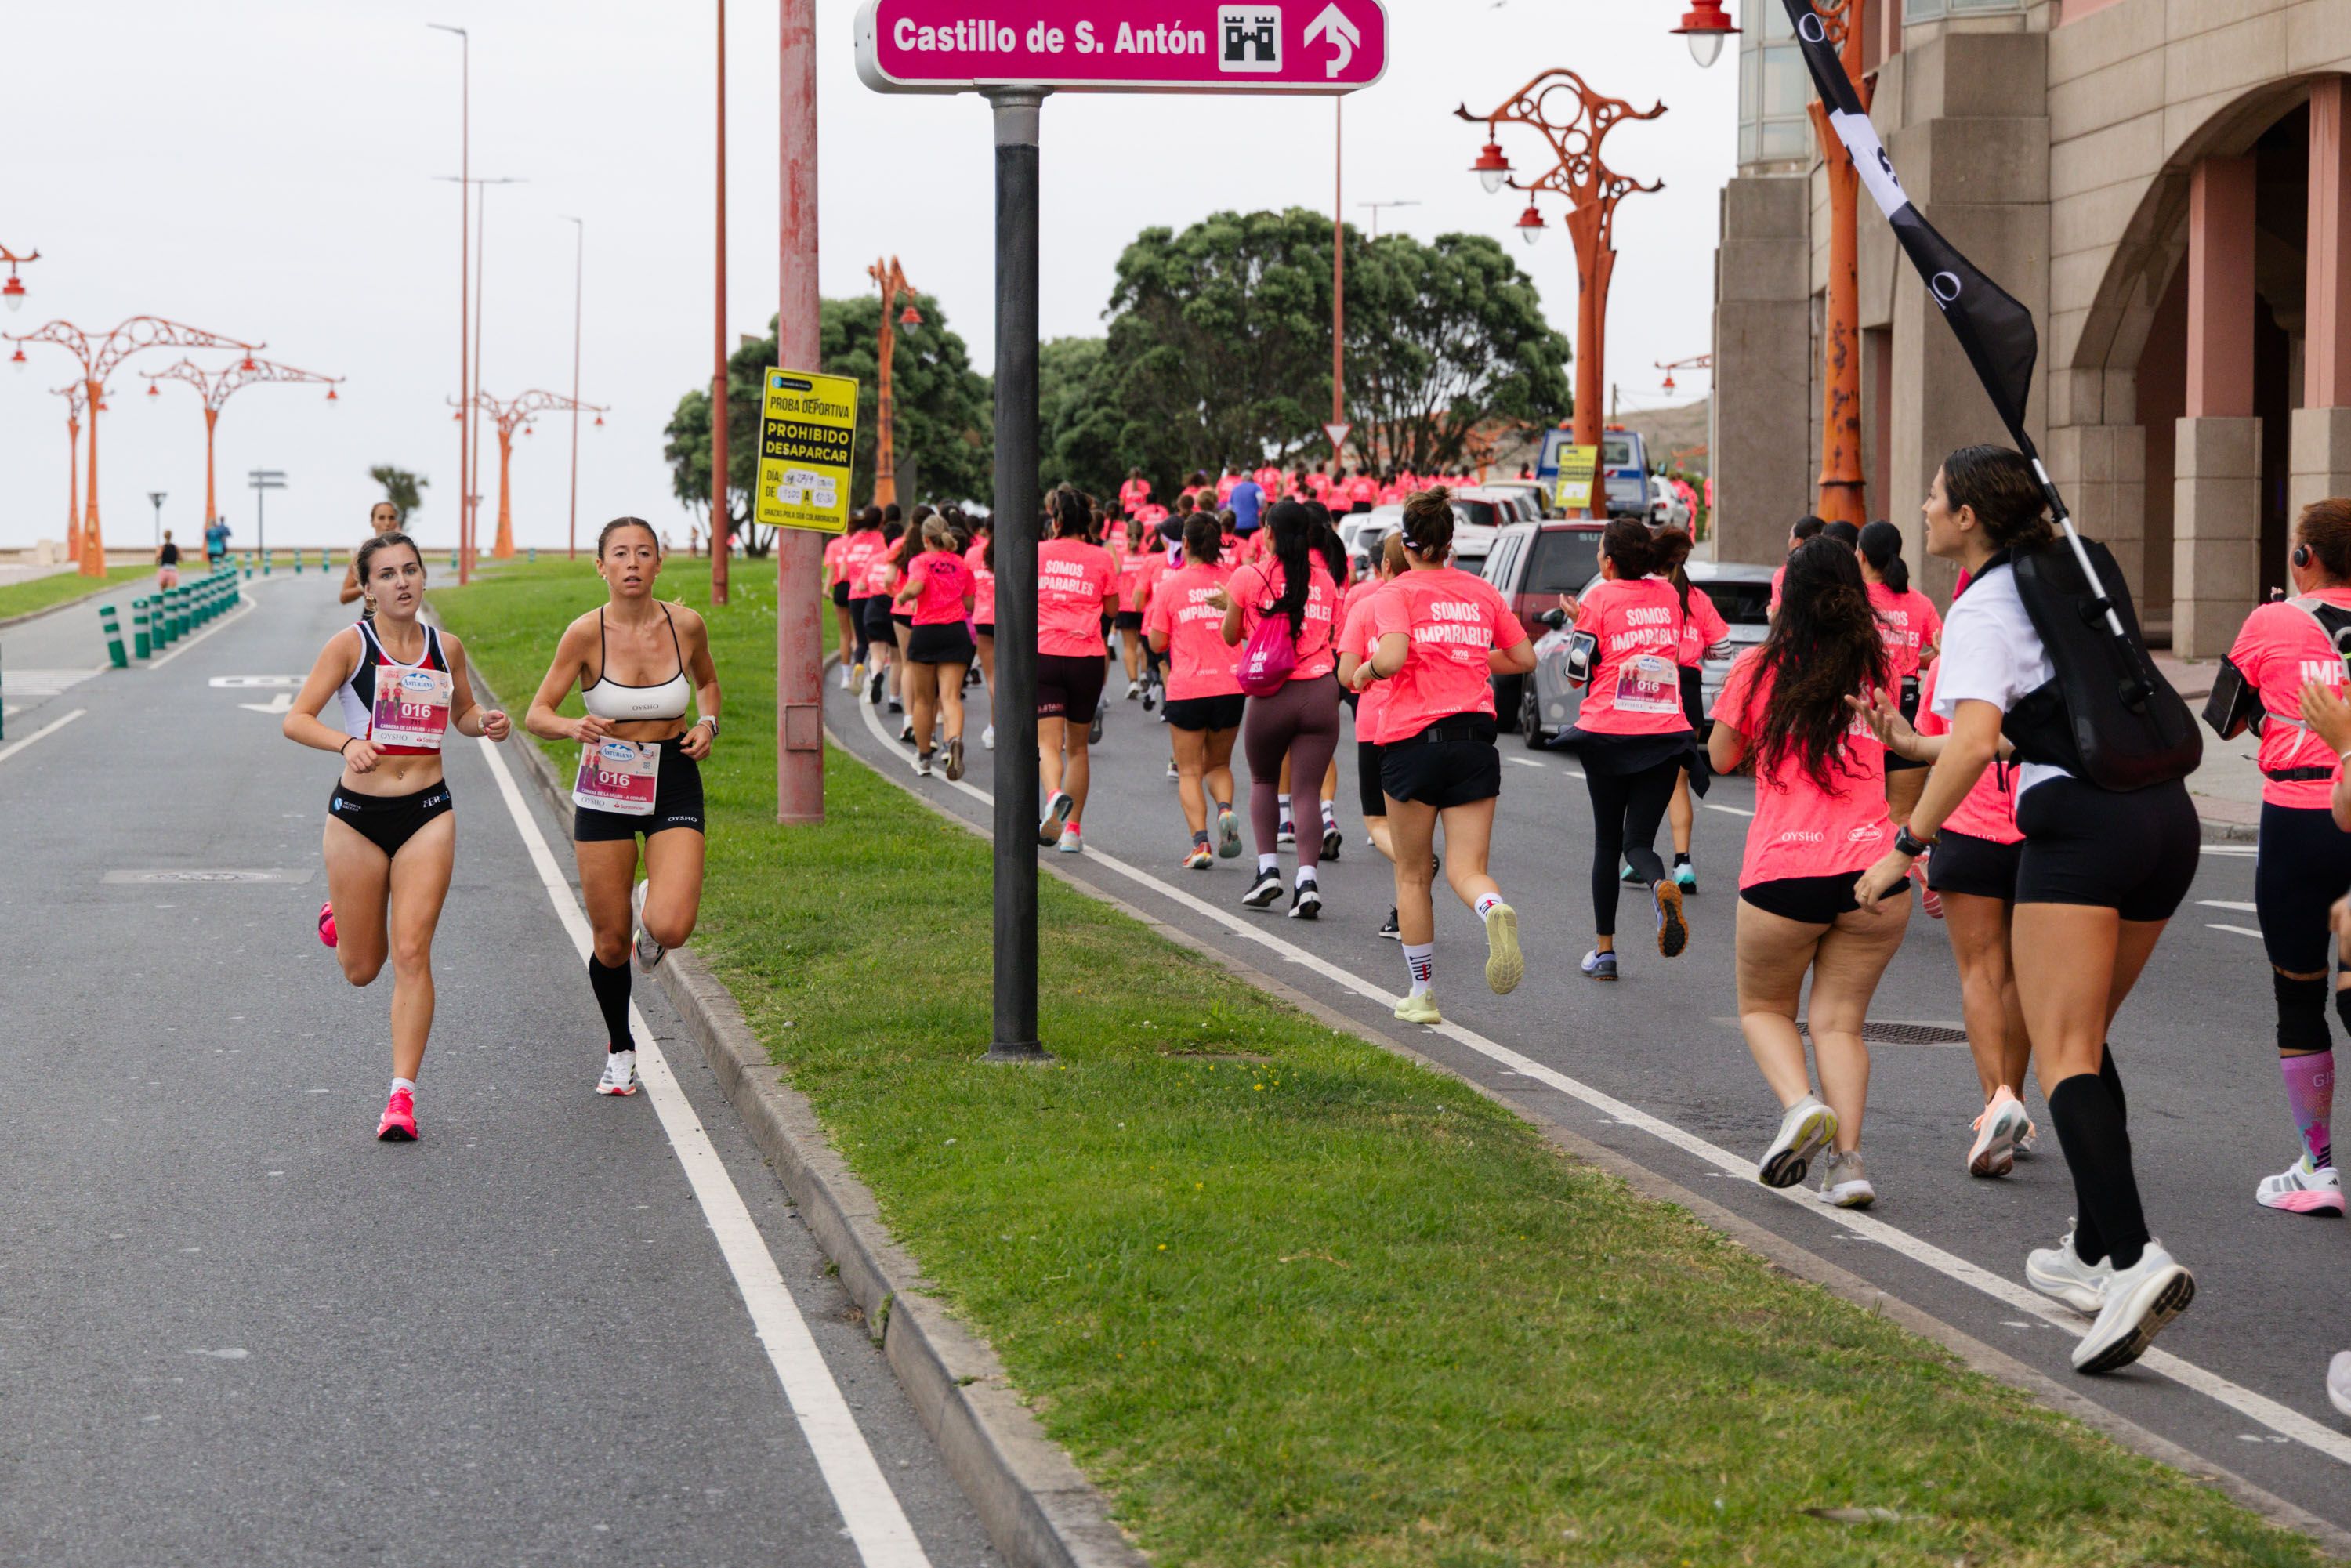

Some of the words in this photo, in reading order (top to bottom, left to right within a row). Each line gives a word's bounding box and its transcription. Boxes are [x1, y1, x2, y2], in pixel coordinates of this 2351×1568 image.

[893, 17, 1017, 53] Castillo
[1026, 20, 1066, 54] de
[1074, 20, 1104, 55] S.
[1114, 20, 1206, 55] Antón
[770, 396, 799, 414] PROBA
[802, 400, 849, 419] DEPORTIVA
[767, 422, 849, 445] PROHIBIDO
[765, 486, 775, 498] DE
[804, 491, 810, 502] A
[806, 512, 840, 523] COLABORACIÓN
[1045, 559, 1084, 578] SOMOS
[1038, 575, 1095, 596] MPARABLES
[1178, 604, 1225, 625] IMPARAB
[1430, 601, 1480, 622] SOMOS
[1625, 607, 1672, 626] SOMOS
[1637, 680, 1660, 692] 016
[401, 704, 431, 718] 016
[632, 703, 659, 712] OYSHO
[381, 733, 408, 741] OYSHO
[602, 748, 633, 759] ASTURIANA
[599, 771, 630, 786] 016
[581, 796, 605, 806] OYSHO
[1781, 831, 1824, 842] OYSHO
[1409, 954, 1432, 981] QUIT
